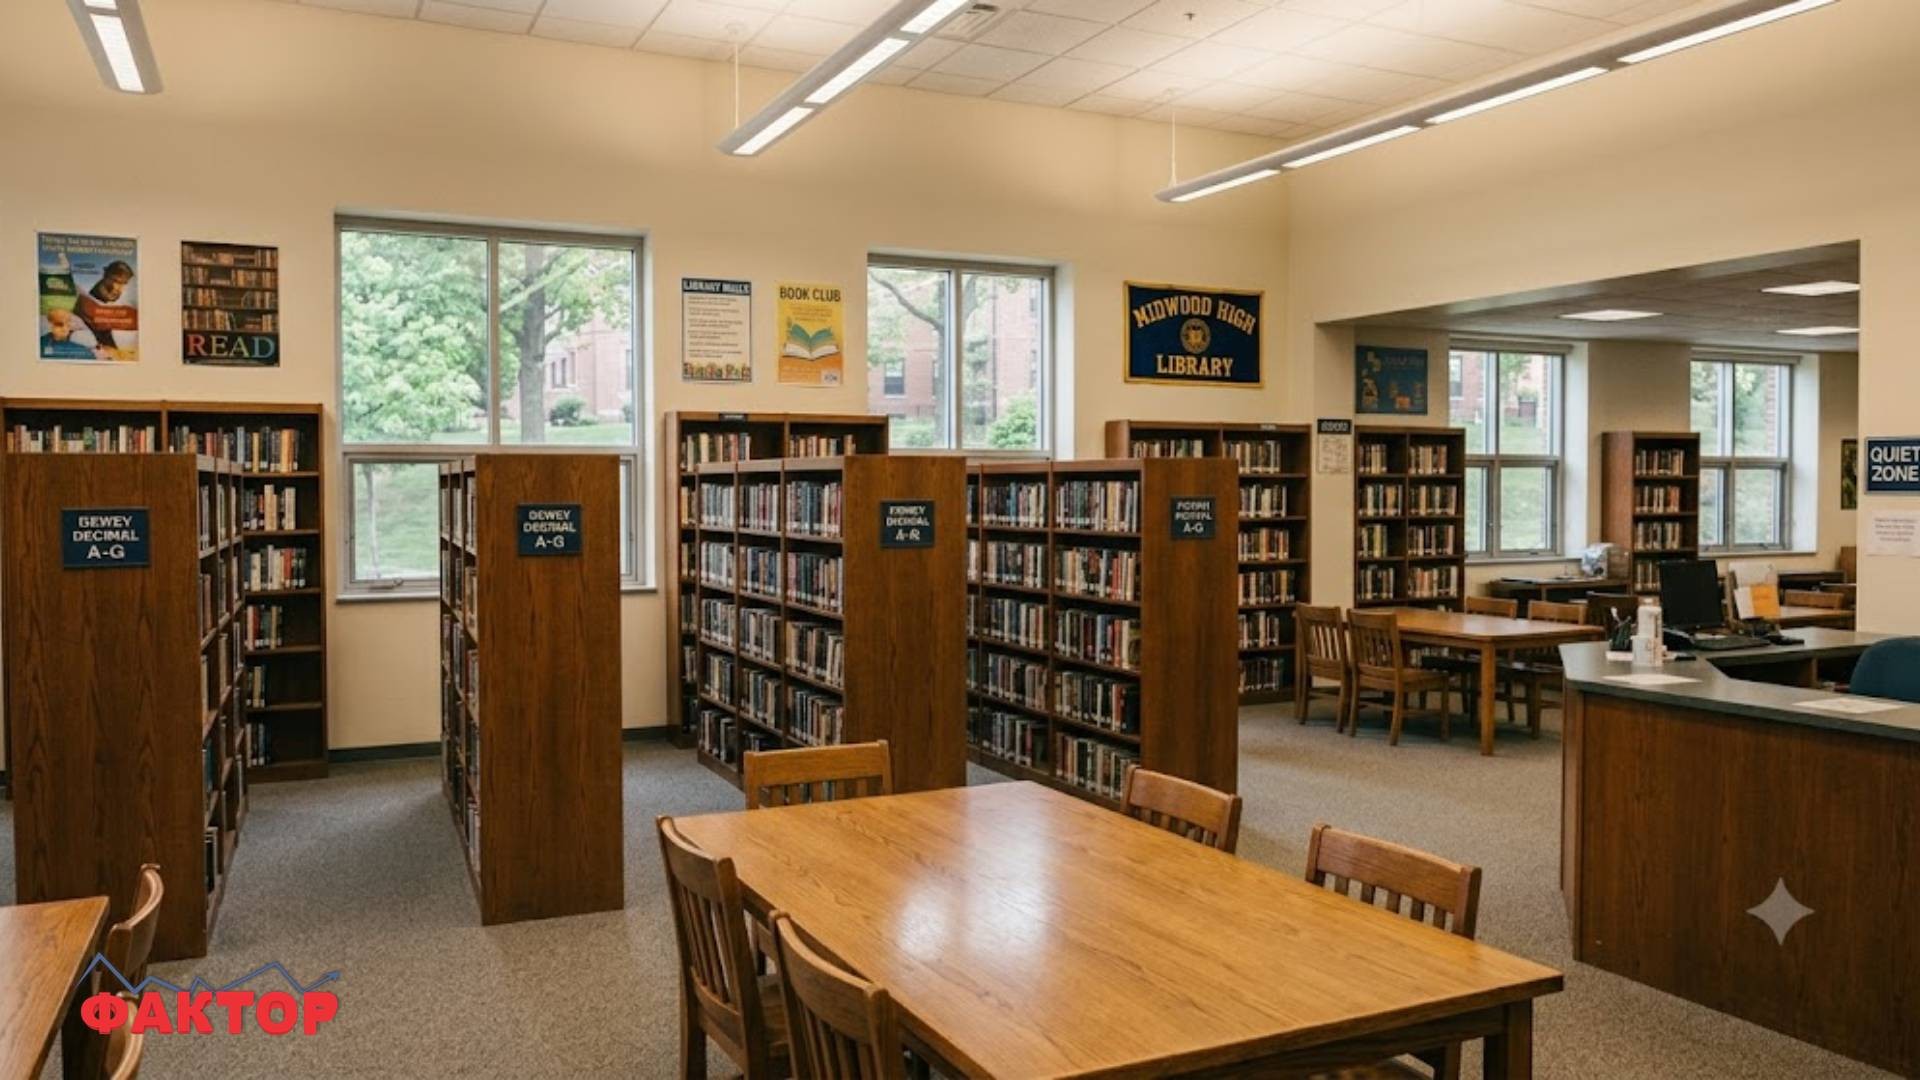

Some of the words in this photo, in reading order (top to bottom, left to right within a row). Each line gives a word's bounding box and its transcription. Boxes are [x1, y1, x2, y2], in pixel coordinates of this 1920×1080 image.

[780, 287, 810, 300] BOOK
[812, 288, 841, 302] CLUB
[1133, 296, 1212, 329] MIDWOOD
[1216, 300, 1256, 336] HIGH
[187, 334, 275, 358] READ
[1156, 354, 1233, 377] LIBRARY
[1870, 446, 1920, 464] QUIET
[1871, 465, 1919, 482] ZONE
[1183, 522, 1205, 533] A-G
[72, 530, 140, 542] DECIMAL
[534, 535, 566, 549] A-G
[86, 544, 126, 560] A-G
